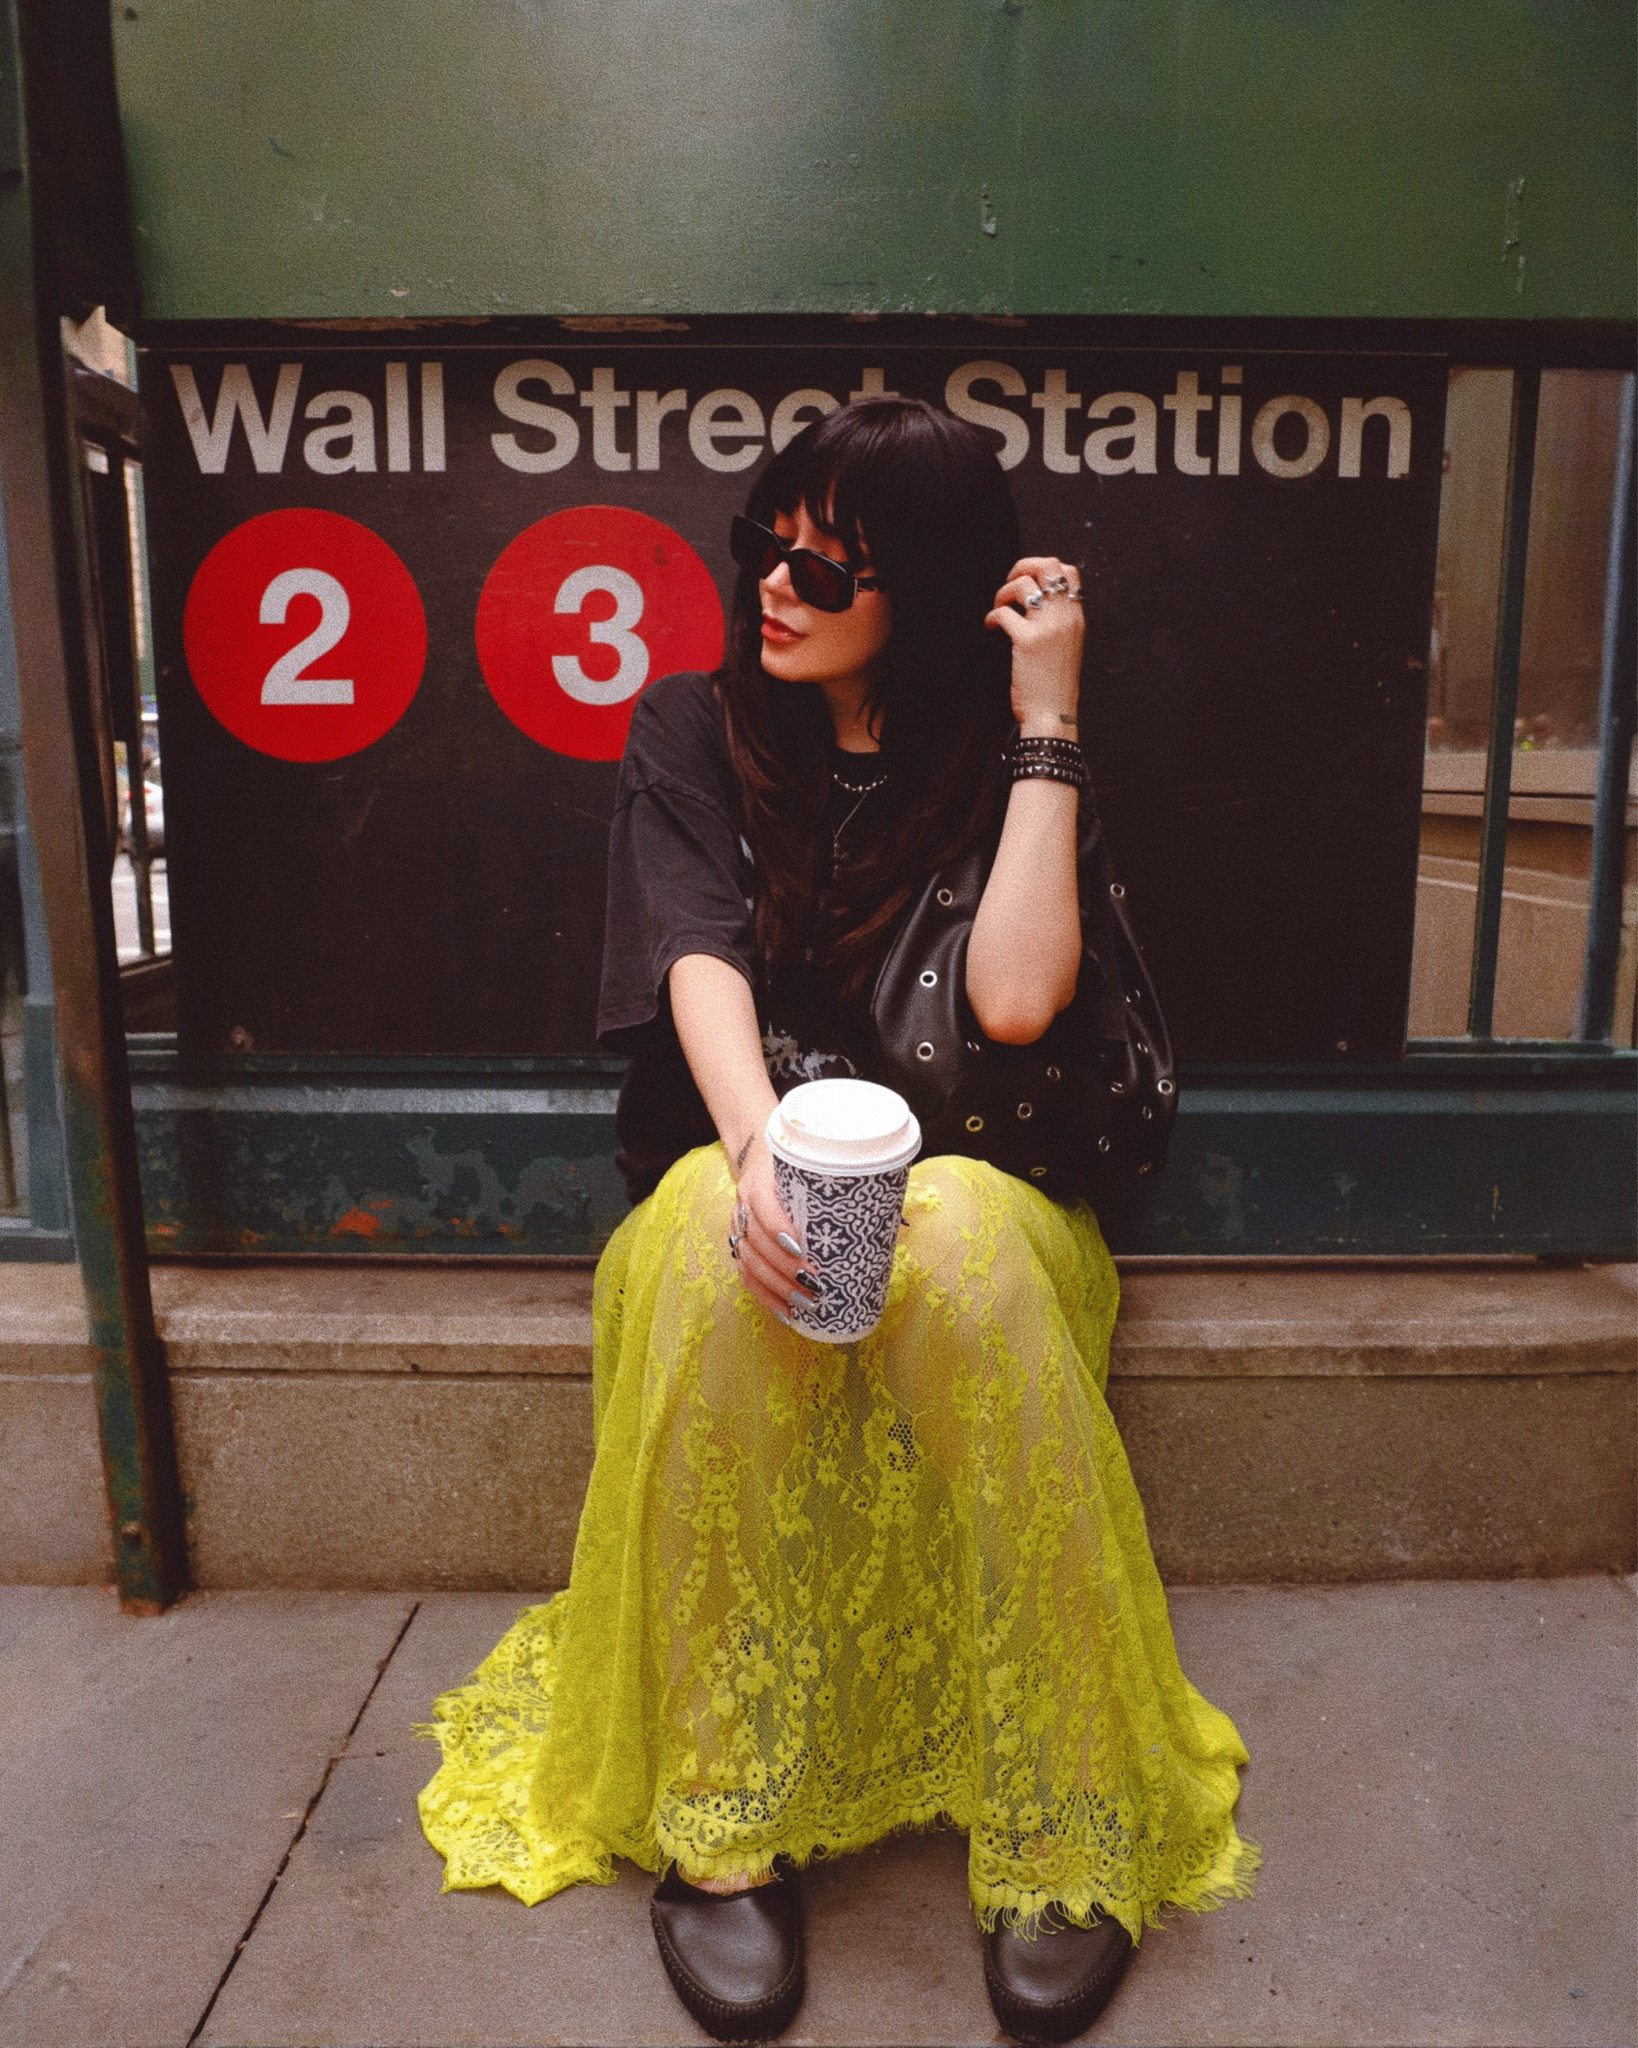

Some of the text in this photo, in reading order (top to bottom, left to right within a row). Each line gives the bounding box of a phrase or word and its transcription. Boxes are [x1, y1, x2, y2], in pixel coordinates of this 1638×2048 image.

[169, 362, 447, 475] Wall
[945, 360, 1412, 479] Station
[259, 564, 650, 706] 2 3
